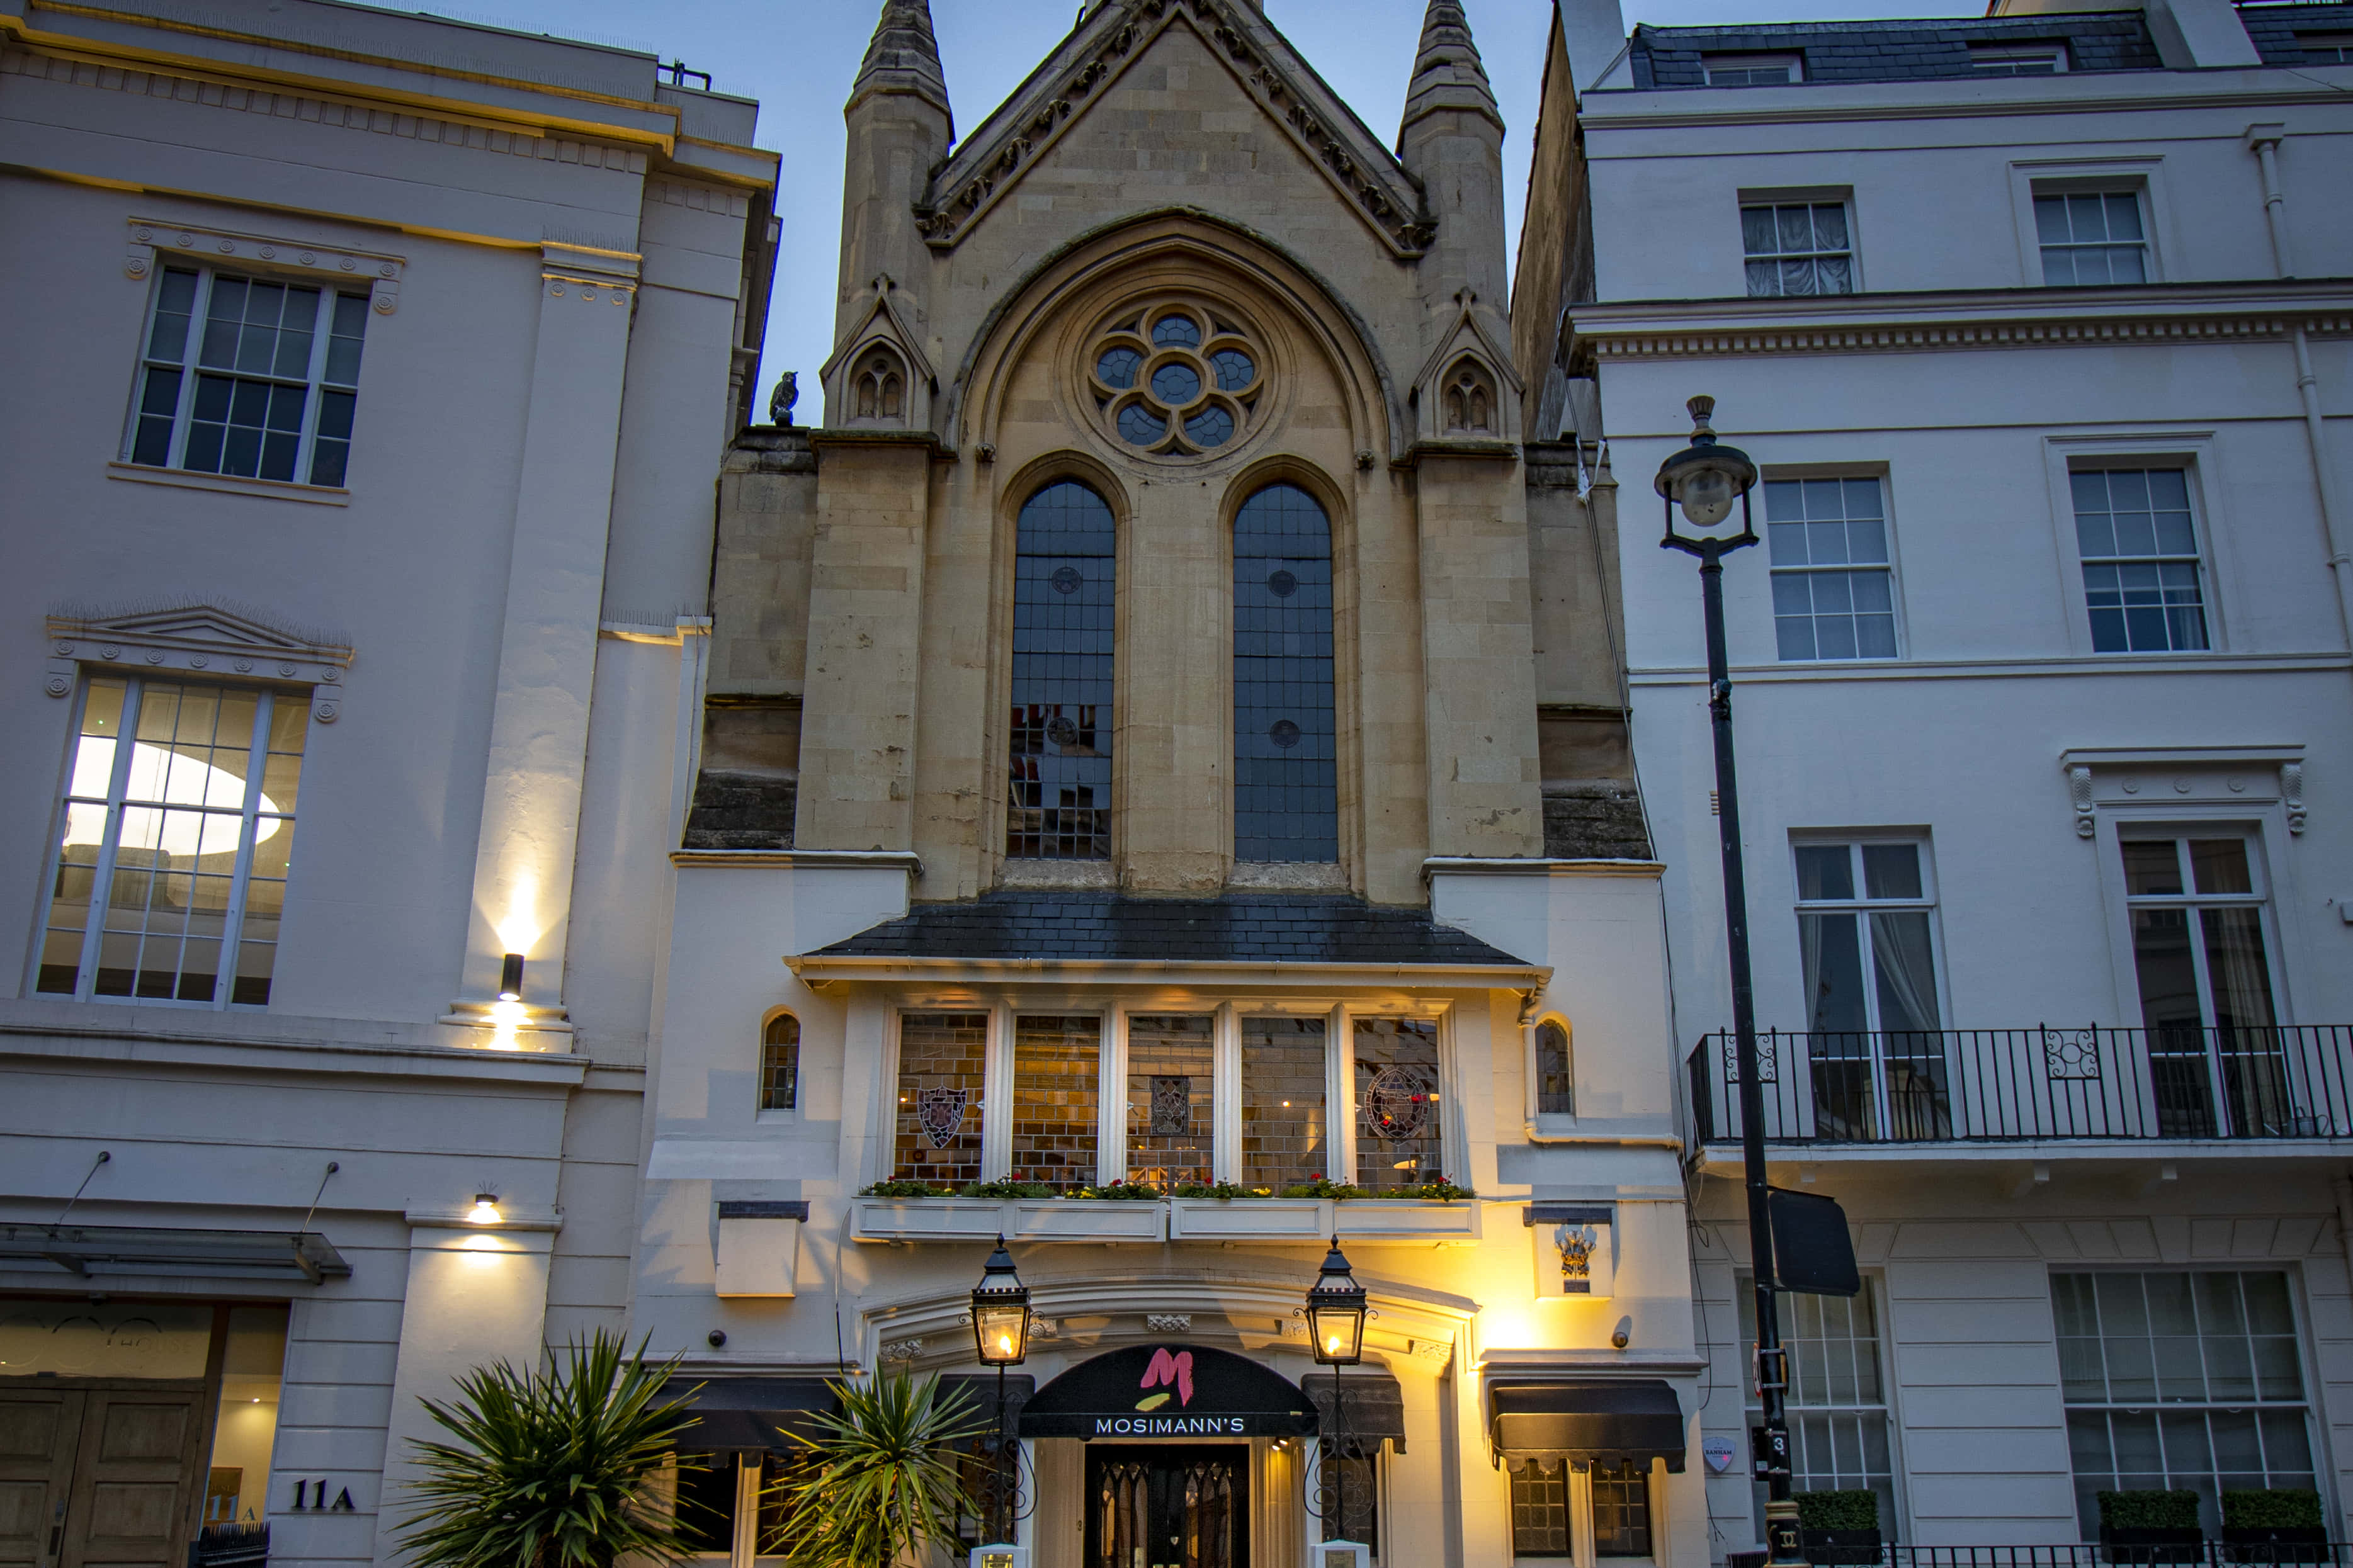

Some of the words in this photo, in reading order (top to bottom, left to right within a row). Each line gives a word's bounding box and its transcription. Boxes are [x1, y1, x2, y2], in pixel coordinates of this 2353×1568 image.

[1096, 1418, 1244, 1433] MOSIMANN'S
[1774, 1437, 1784, 1451] 3
[292, 1479, 355, 1509] 11A
